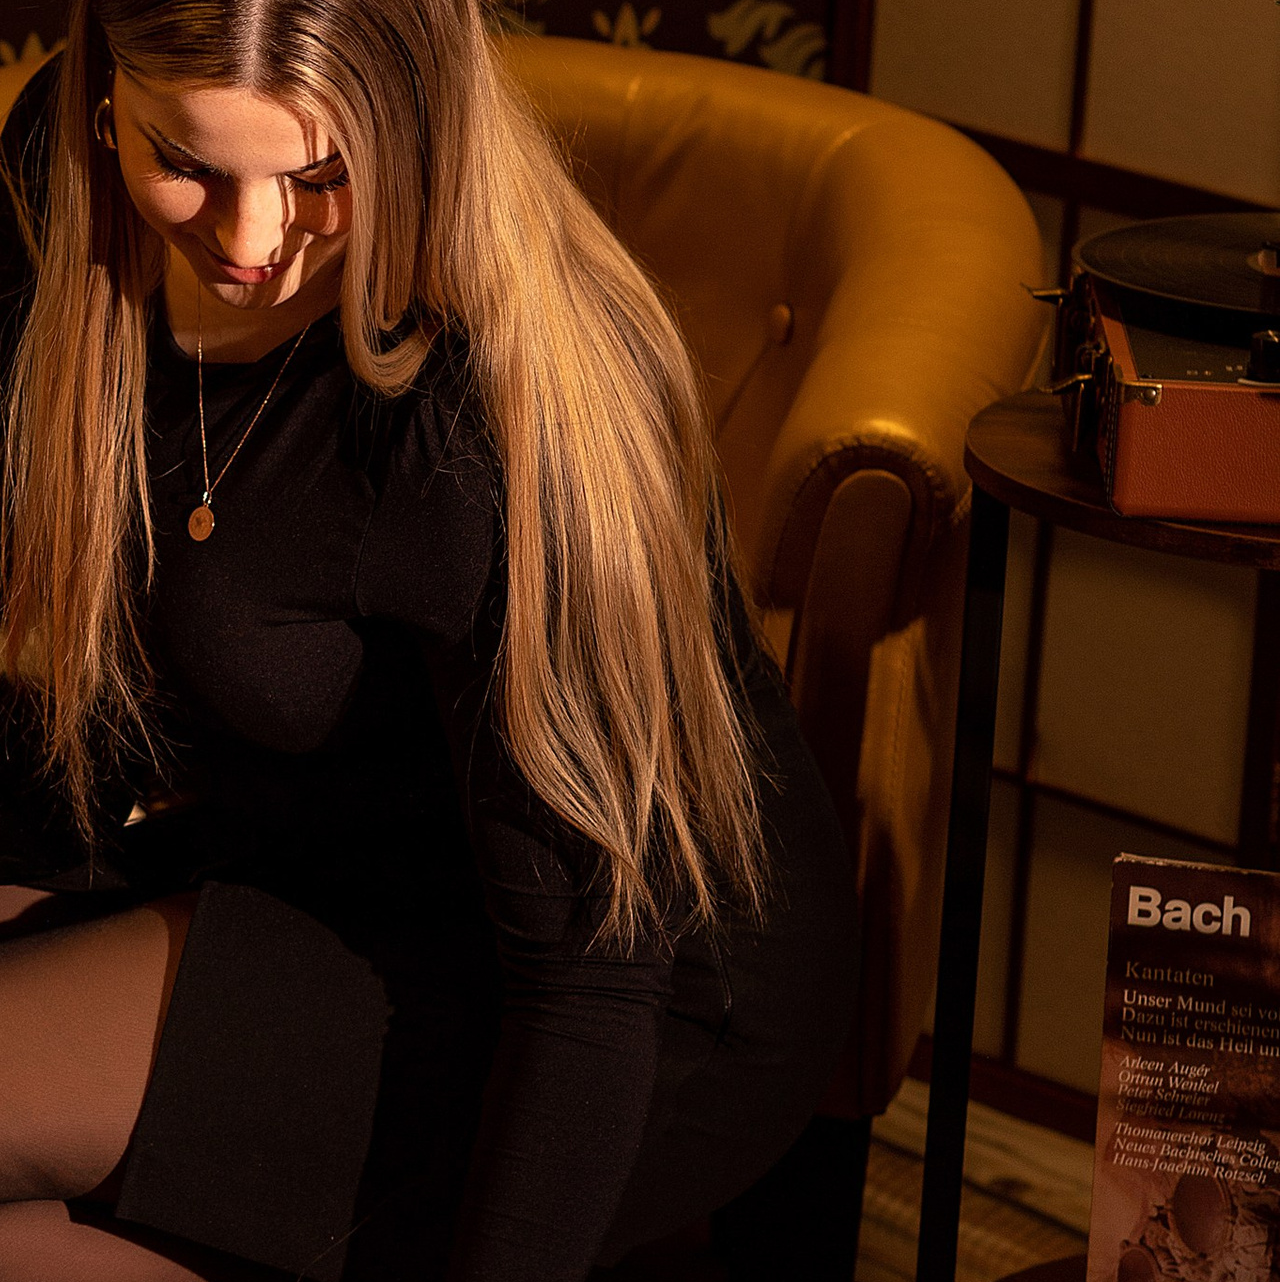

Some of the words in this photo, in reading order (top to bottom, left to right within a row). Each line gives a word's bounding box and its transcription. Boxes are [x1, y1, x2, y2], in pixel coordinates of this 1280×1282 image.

[1127, 885, 1251, 937] Bach
[1125, 961, 1214, 987] Kantaten
[1124, 989, 1172, 1010] Unser
[1176, 995, 1226, 1015] Mund
[1231, 1002, 1252, 1018] sei
[1122, 1006, 1165, 1027] Dazu
[1171, 1011, 1189, 1029] ist
[1194, 1018, 1280, 1040] erschienen
[1120, 1025, 1157, 1045] Nun
[1162, 1029, 1181, 1046] ist
[1186, 1033, 1214, 1050] das
[1219, 1037, 1254, 1054] Heil
[1119, 1055, 1165, 1073] Arleen
[1117, 1084, 1153, 1101] Peter
[1154, 1087, 1210, 1107] Schreier
[1118, 1070, 1163, 1087] Ortrun
[1168, 1075, 1220, 1094] Wenkel
[1116, 1098, 1174, 1120] Siegfried
[1113, 1137, 1156, 1156] Neues
[1160, 1143, 1235, 1165] Bachisches
[1114, 1121, 1214, 1147] Thomanerchor
[1216, 1135, 1266, 1156] Leipzig
[1113, 1152, 1209, 1178] Hans-Joachim
[1213, 1165, 1267, 1185] Rotzsch
